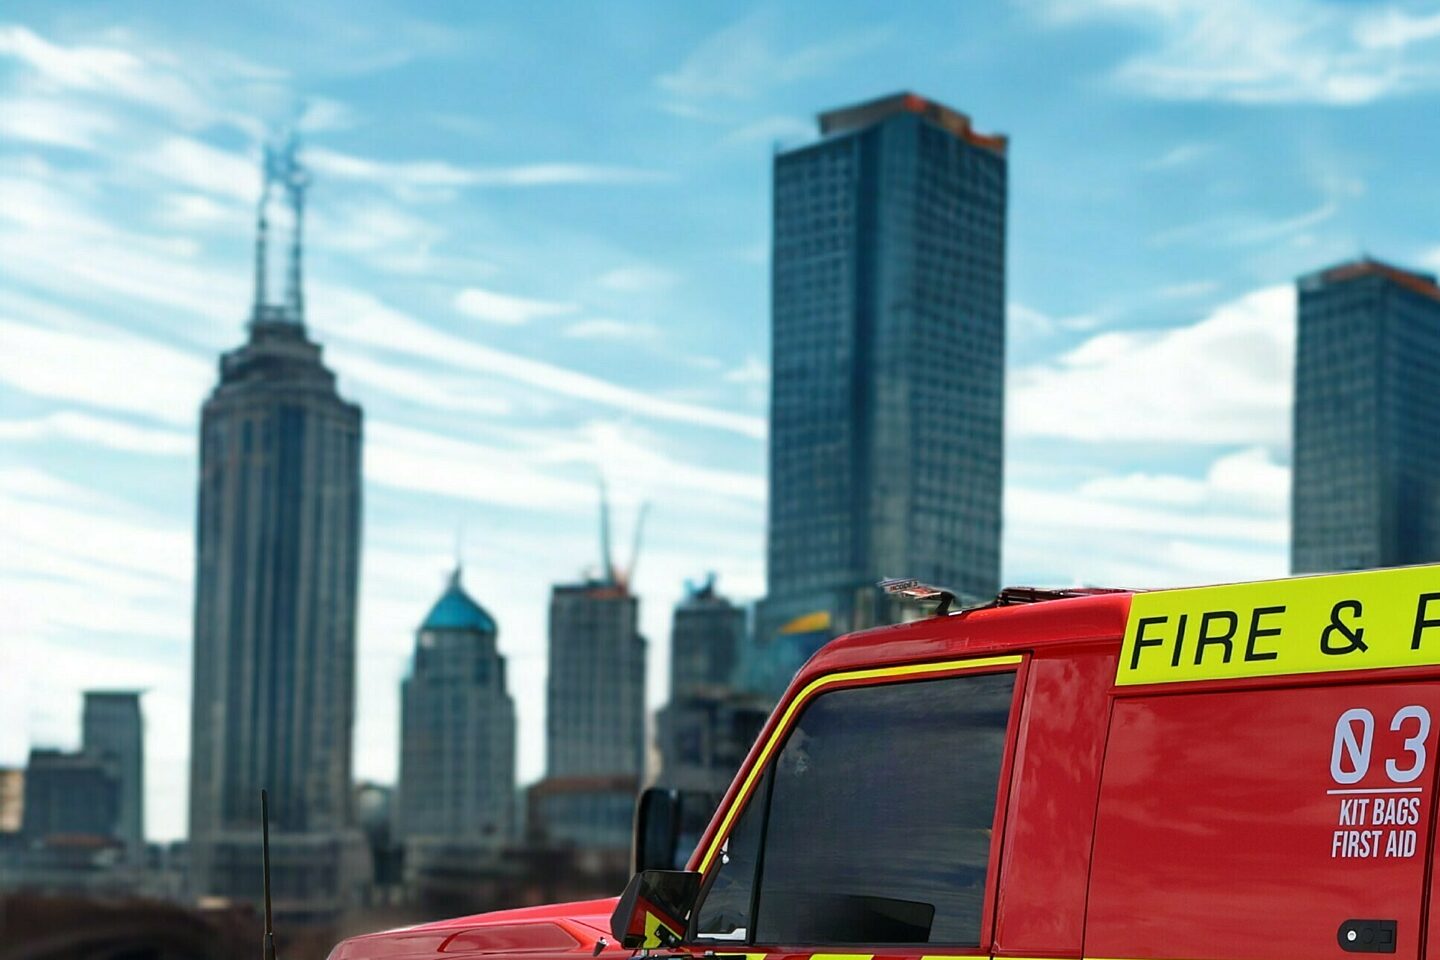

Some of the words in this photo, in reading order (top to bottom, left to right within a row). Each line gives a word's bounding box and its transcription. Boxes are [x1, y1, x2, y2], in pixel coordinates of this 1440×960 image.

[1129, 605, 1286, 670] FIRE
[1320, 599, 1369, 655] &
[1330, 705, 1431, 784] 03
[1339, 798, 1369, 826] KIT
[1372, 797, 1420, 825] BAGS
[1331, 830, 1382, 858] FIRST
[1385, 830, 1417, 858] AID
